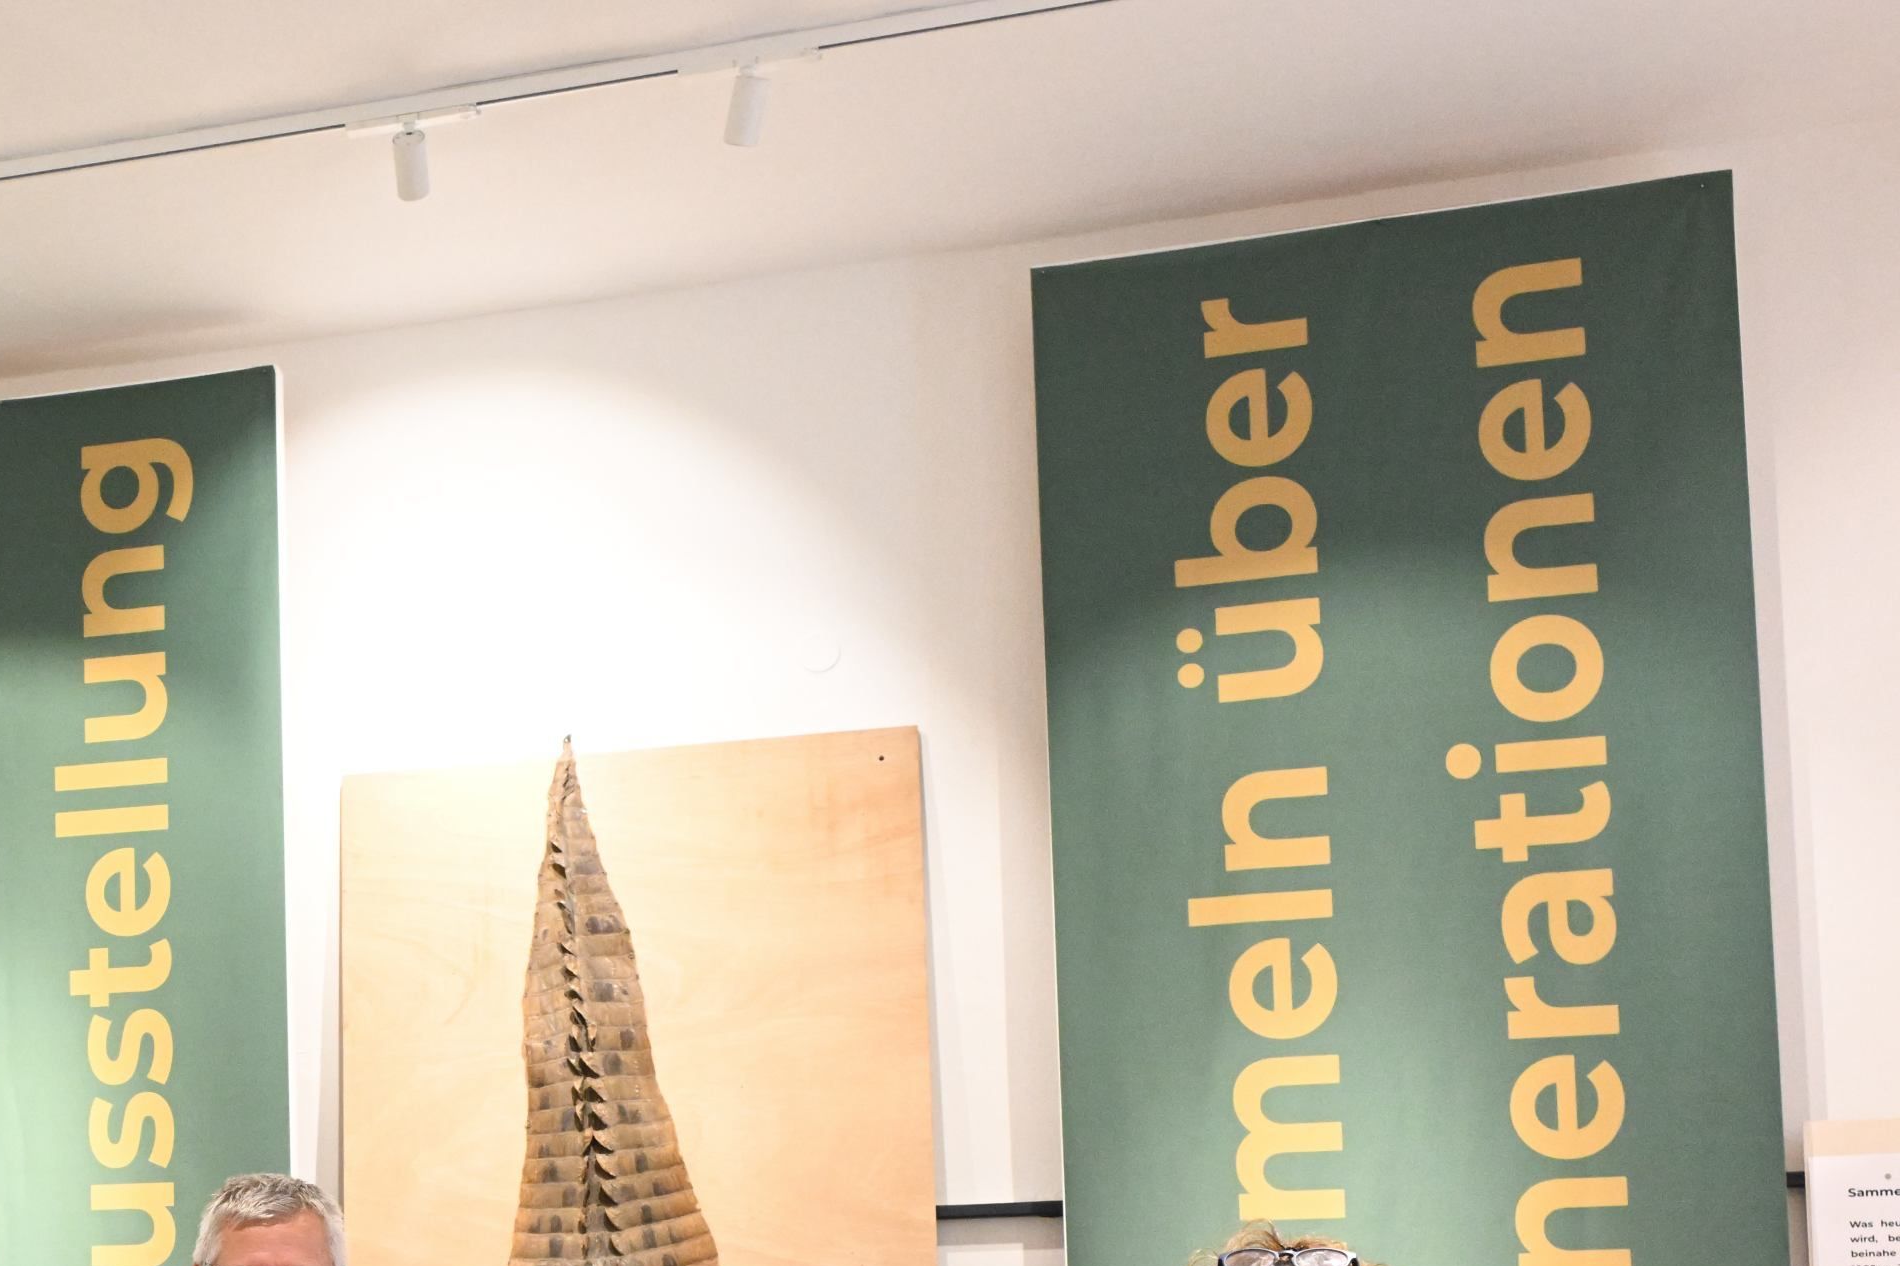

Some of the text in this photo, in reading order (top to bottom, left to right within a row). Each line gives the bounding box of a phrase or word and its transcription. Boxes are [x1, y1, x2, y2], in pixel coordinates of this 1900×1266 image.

[1173, 297, 1326, 705] über
[1849, 1220, 1874, 1229] Was
[1849, 1234, 1879, 1244] wird,
[1850, 1249, 1897, 1258] beinahe
